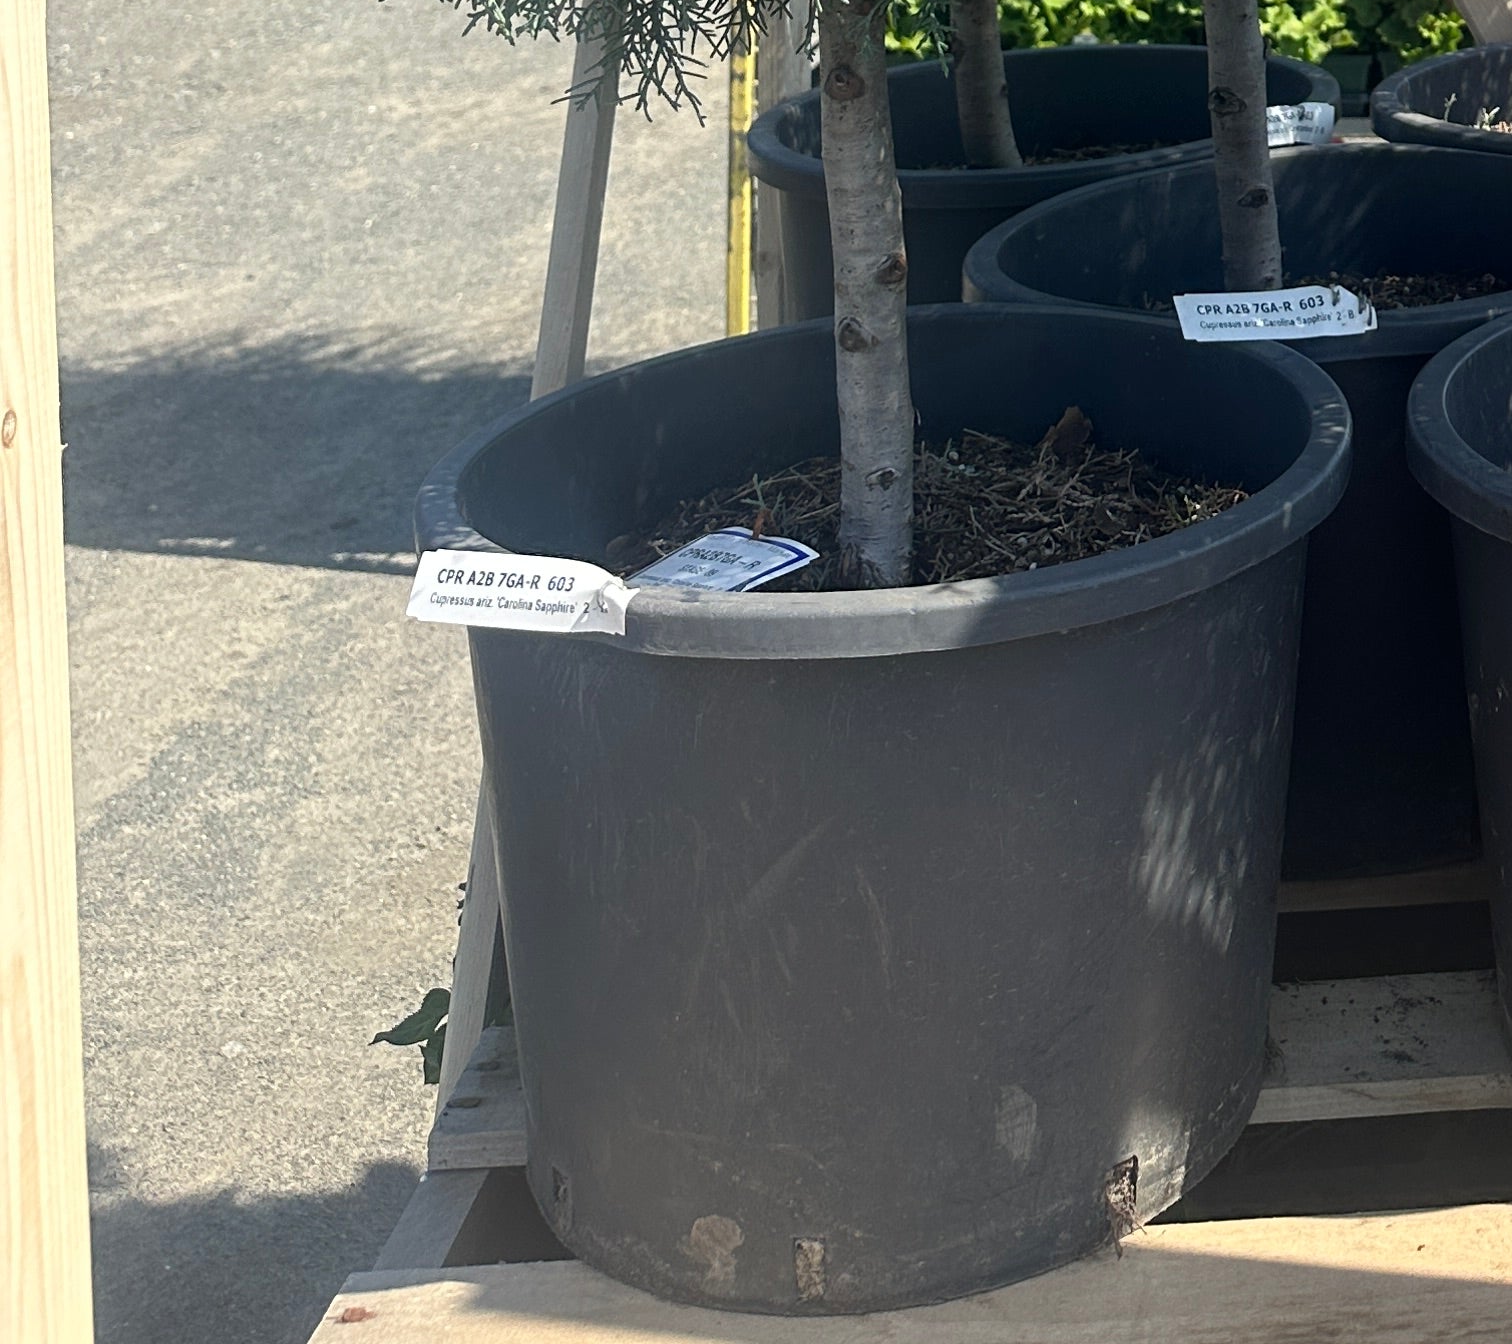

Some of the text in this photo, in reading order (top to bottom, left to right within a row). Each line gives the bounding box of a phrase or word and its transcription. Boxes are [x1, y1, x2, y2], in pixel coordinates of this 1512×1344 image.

[1196, 294, 1325, 315] CPR A2B 7GA-R 603
[437, 568, 575, 592] CPR A2B 7GA-R 603
[430, 591, 475, 608] Cupressus
